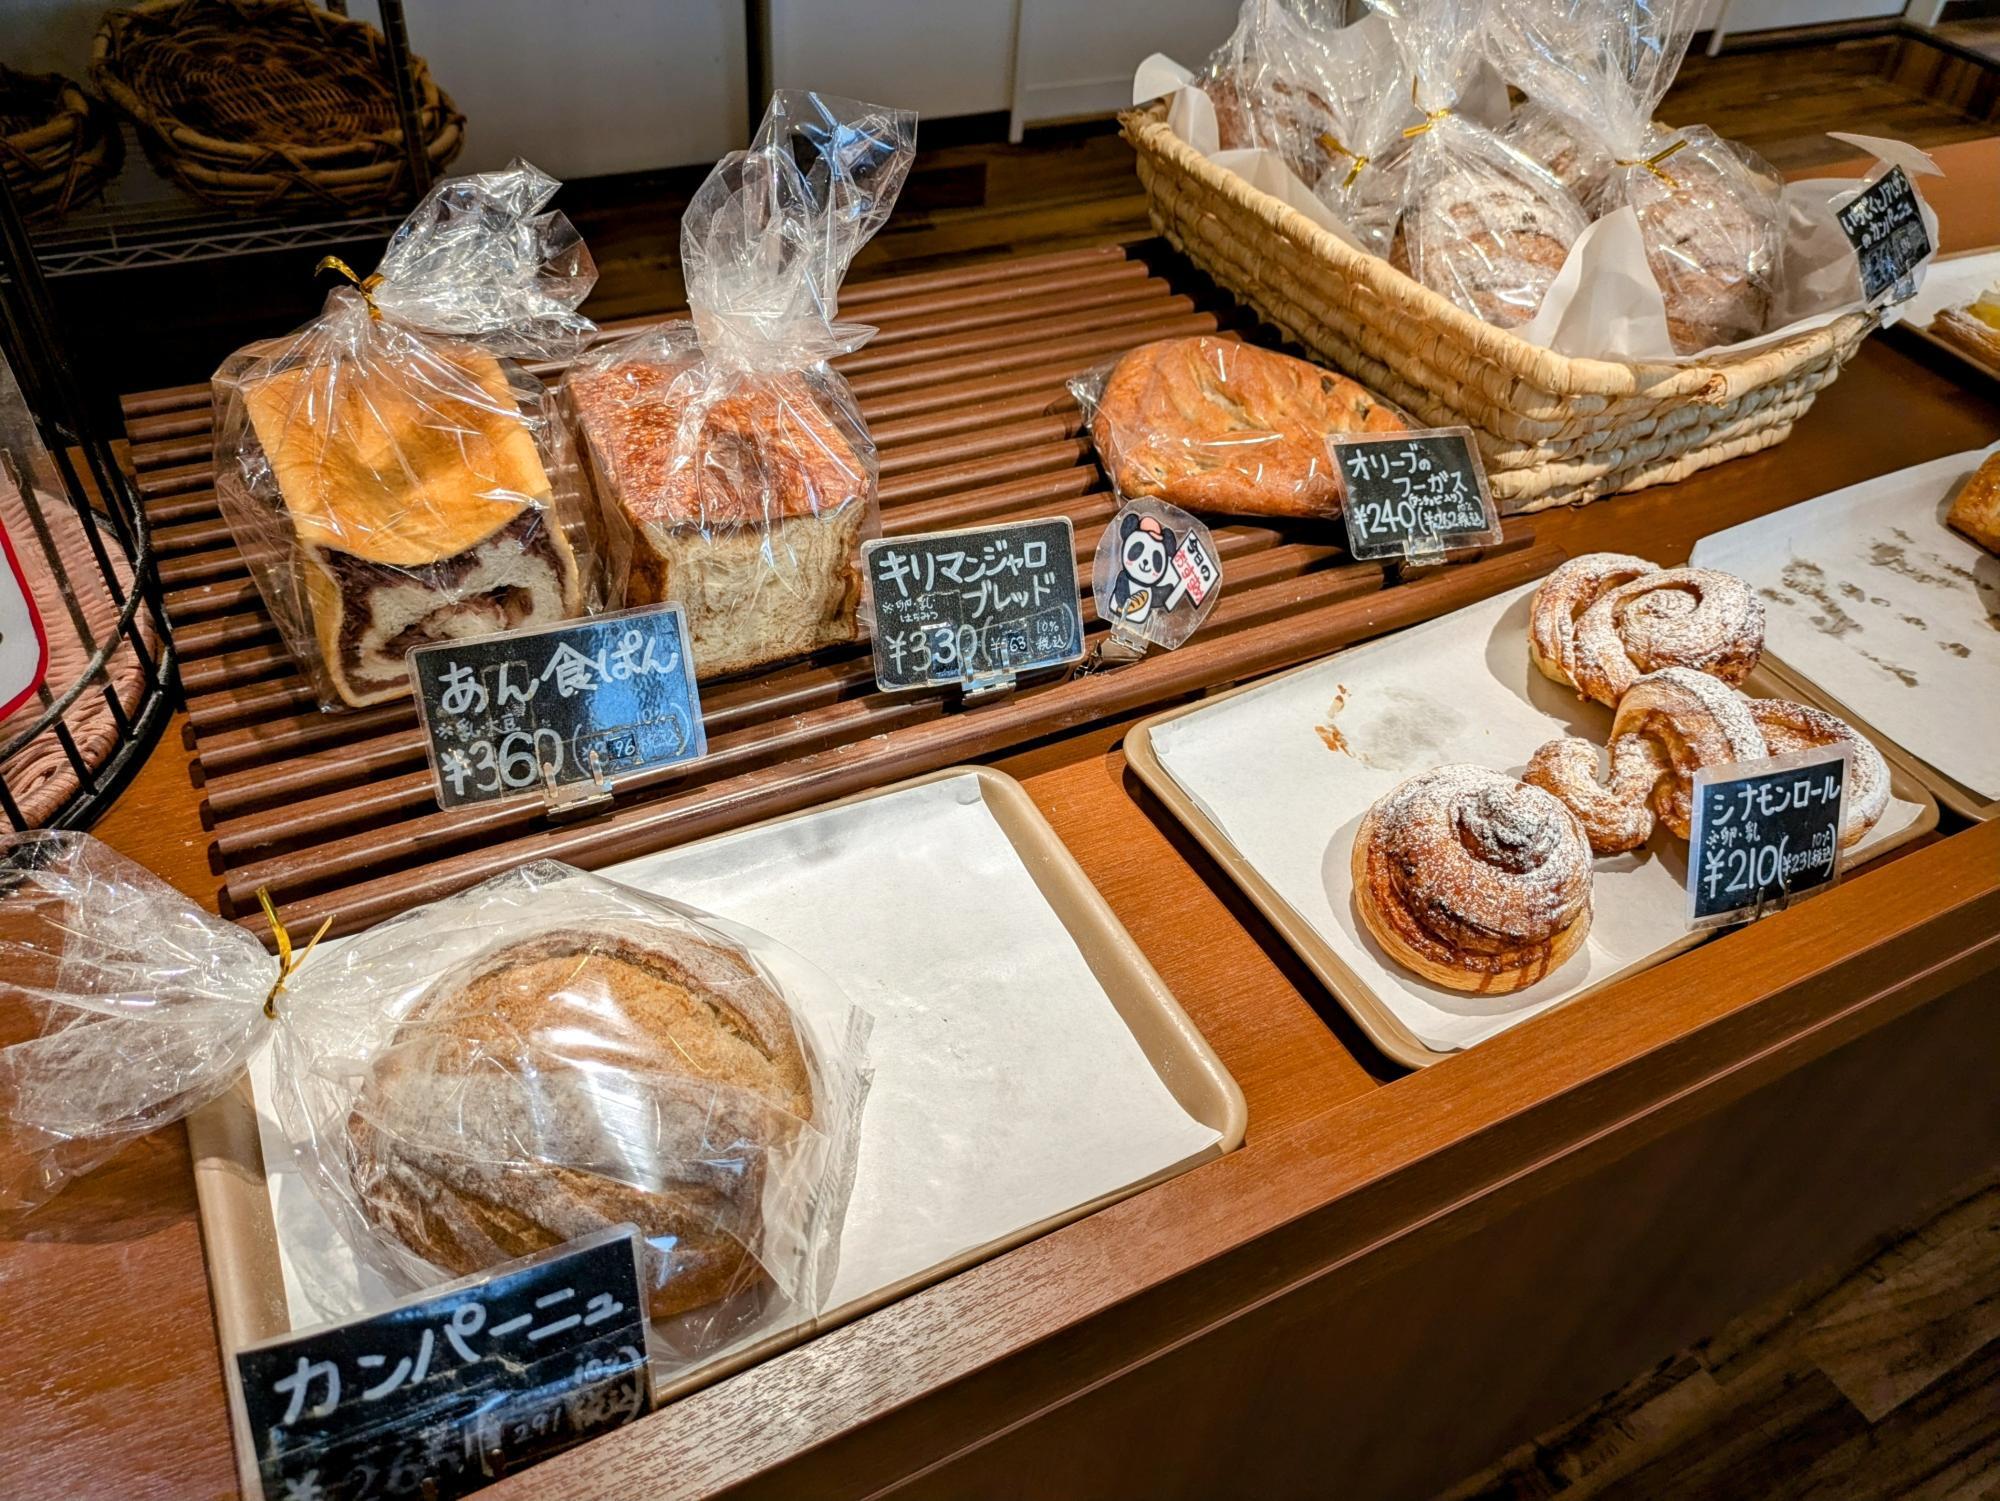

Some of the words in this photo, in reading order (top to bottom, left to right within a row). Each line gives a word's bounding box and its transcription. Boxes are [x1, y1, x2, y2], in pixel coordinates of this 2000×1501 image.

[1346, 443, 1432, 480] オリーブの
[1392, 470, 1469, 497] フーガス
[877, 538, 1047, 597] キリマンジャロ
[962, 572, 1056, 618] ブレッド
[437, 629, 679, 714] あん食ぱん
[1711, 776, 1841, 825] シナモンロール
[274, 1287, 624, 1425] カンパーニュ
